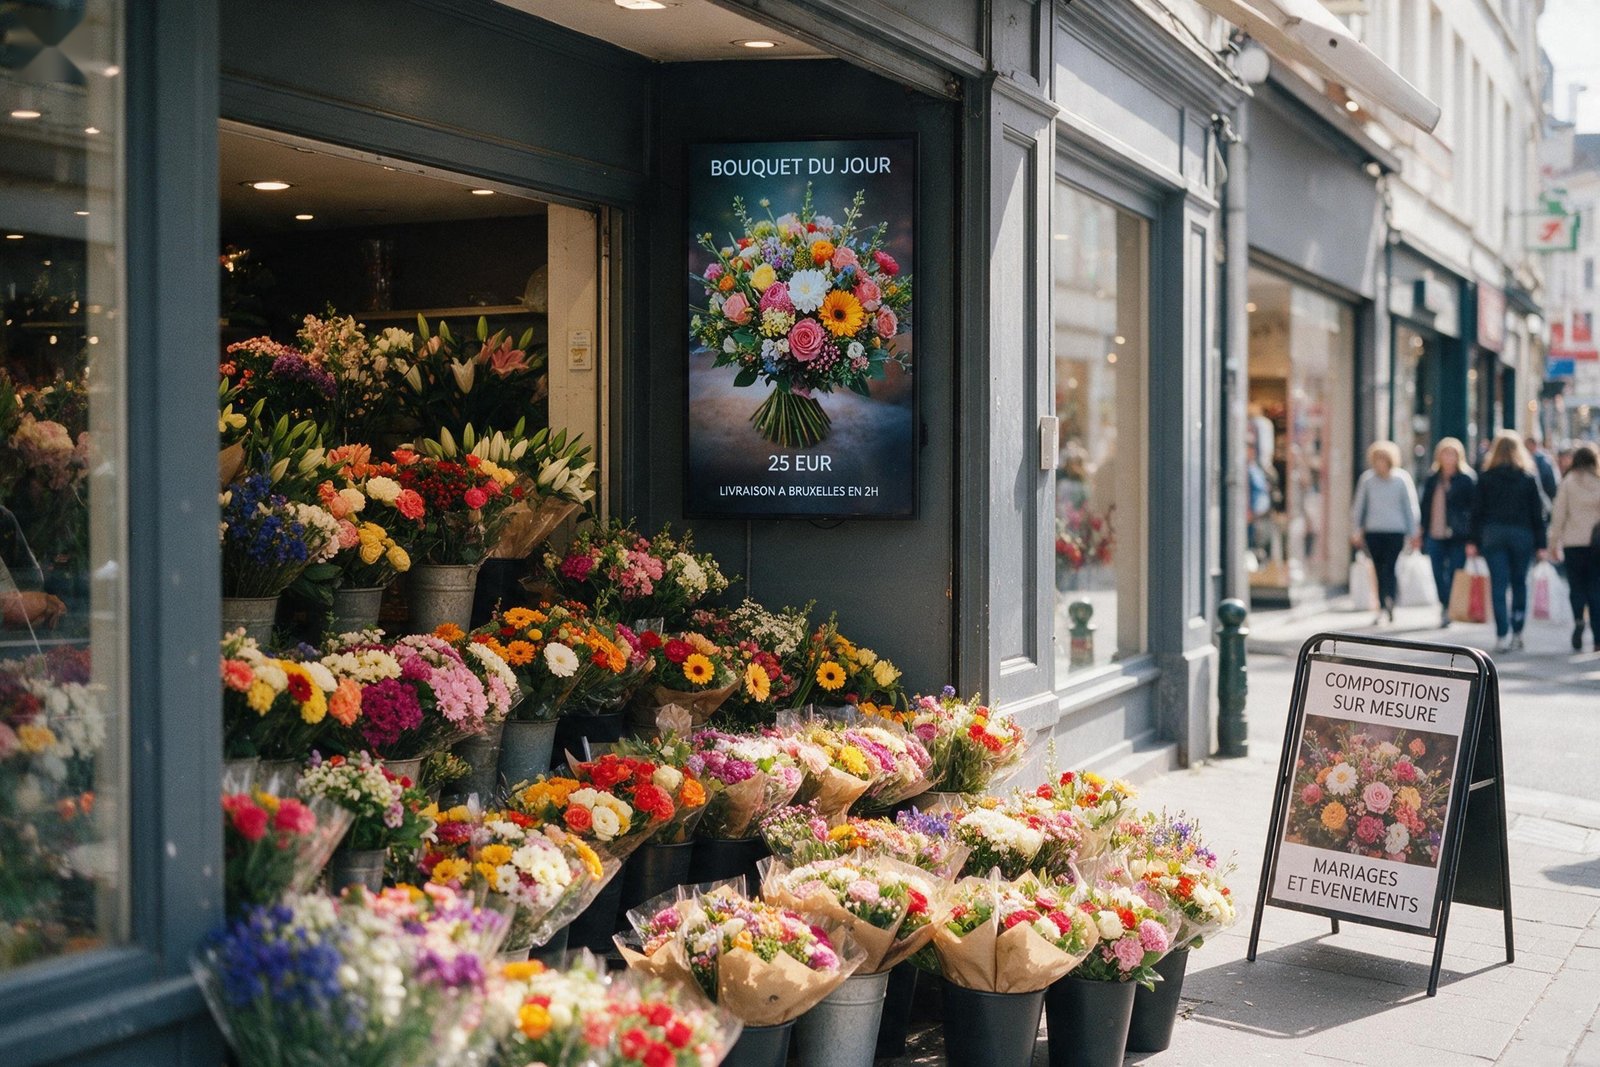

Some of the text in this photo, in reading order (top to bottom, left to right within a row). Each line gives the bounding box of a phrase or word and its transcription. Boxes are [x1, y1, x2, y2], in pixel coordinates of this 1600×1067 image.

[711, 156, 891, 178] BOUQUET DU JOUR
[768, 455, 832, 472] 25 EUR
[719, 486, 879, 497] LIVRAISON A BRUXELLES EN 2H
[1325, 672, 1450, 703] COMPOSITIONS
[1333, 694, 1438, 723] SUR MESURE
[1313, 857, 1399, 887] MARIAGES
[1287, 874, 1419, 913] ET EVENEMENTS
